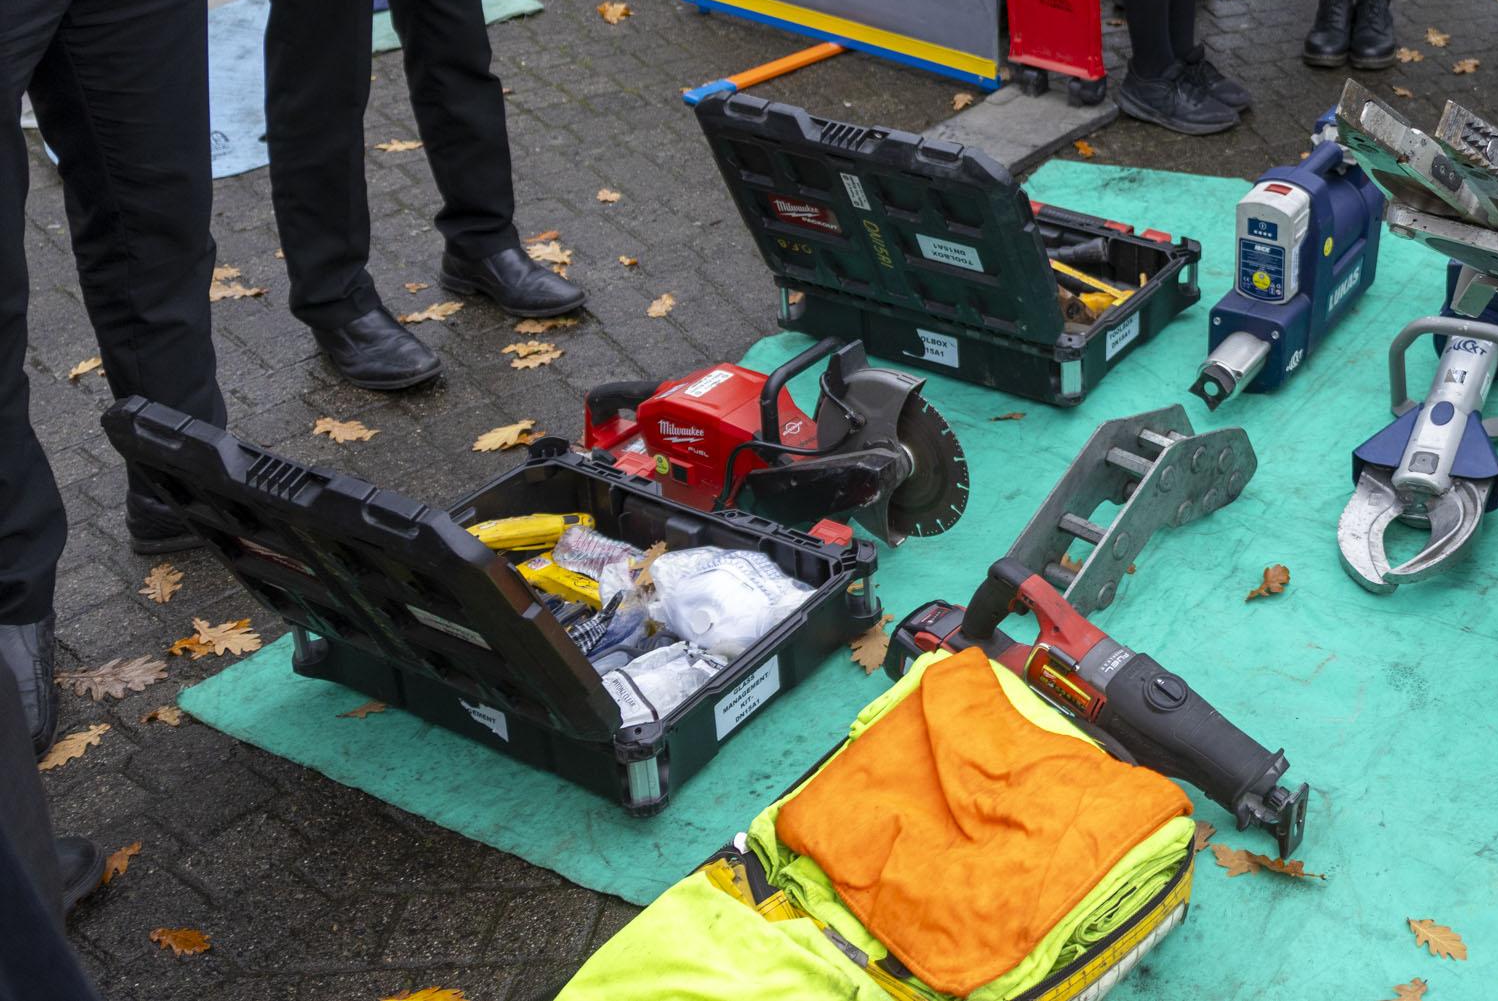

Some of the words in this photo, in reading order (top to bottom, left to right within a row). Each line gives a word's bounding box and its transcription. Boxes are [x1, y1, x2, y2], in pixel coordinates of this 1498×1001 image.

[773, 199, 820, 213] Milwaukee
[932, 251, 974, 266] TOOLBOX
[1328, 266, 1361, 312] LUKAS
[1109, 317, 1135, 340] TOOLBOX
[920, 335, 948, 348] OLBOX
[925, 347, 945, 358] 15A1
[658, 420, 704, 437] Milwaukee
[687, 446, 709, 458] FUEL
[1104, 652, 1130, 673] FUEL
[722, 671, 769, 714] MANAGEMENT
[733, 674, 755, 695] GLASS
[735, 698, 760, 722] DN15A1
